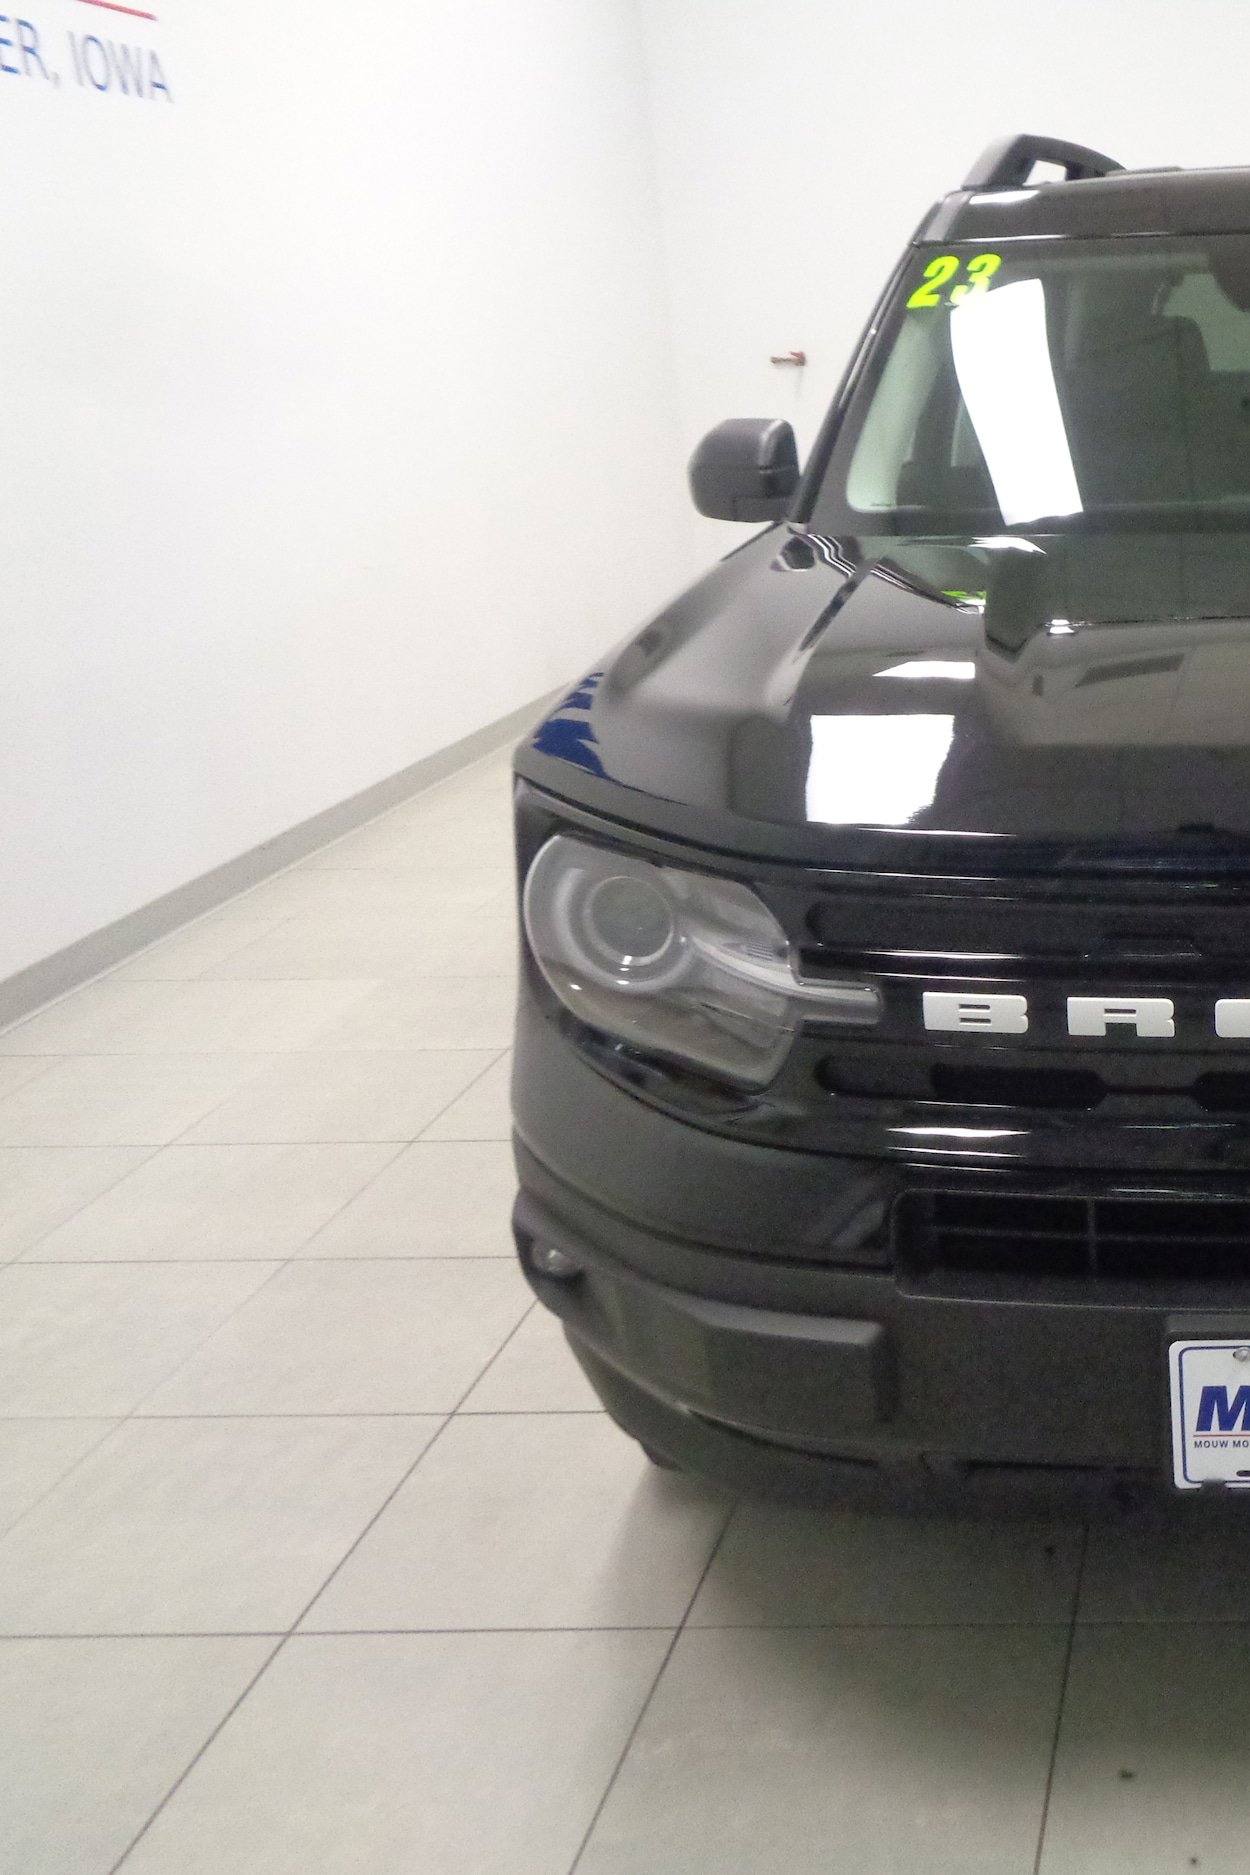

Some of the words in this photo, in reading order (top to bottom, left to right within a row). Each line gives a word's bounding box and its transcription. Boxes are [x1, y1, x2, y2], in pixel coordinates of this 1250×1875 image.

[67, 30, 175, 104] IOWA
[906, 253, 1003, 309] 23
[1194, 1440, 1229, 1449] MOUW
